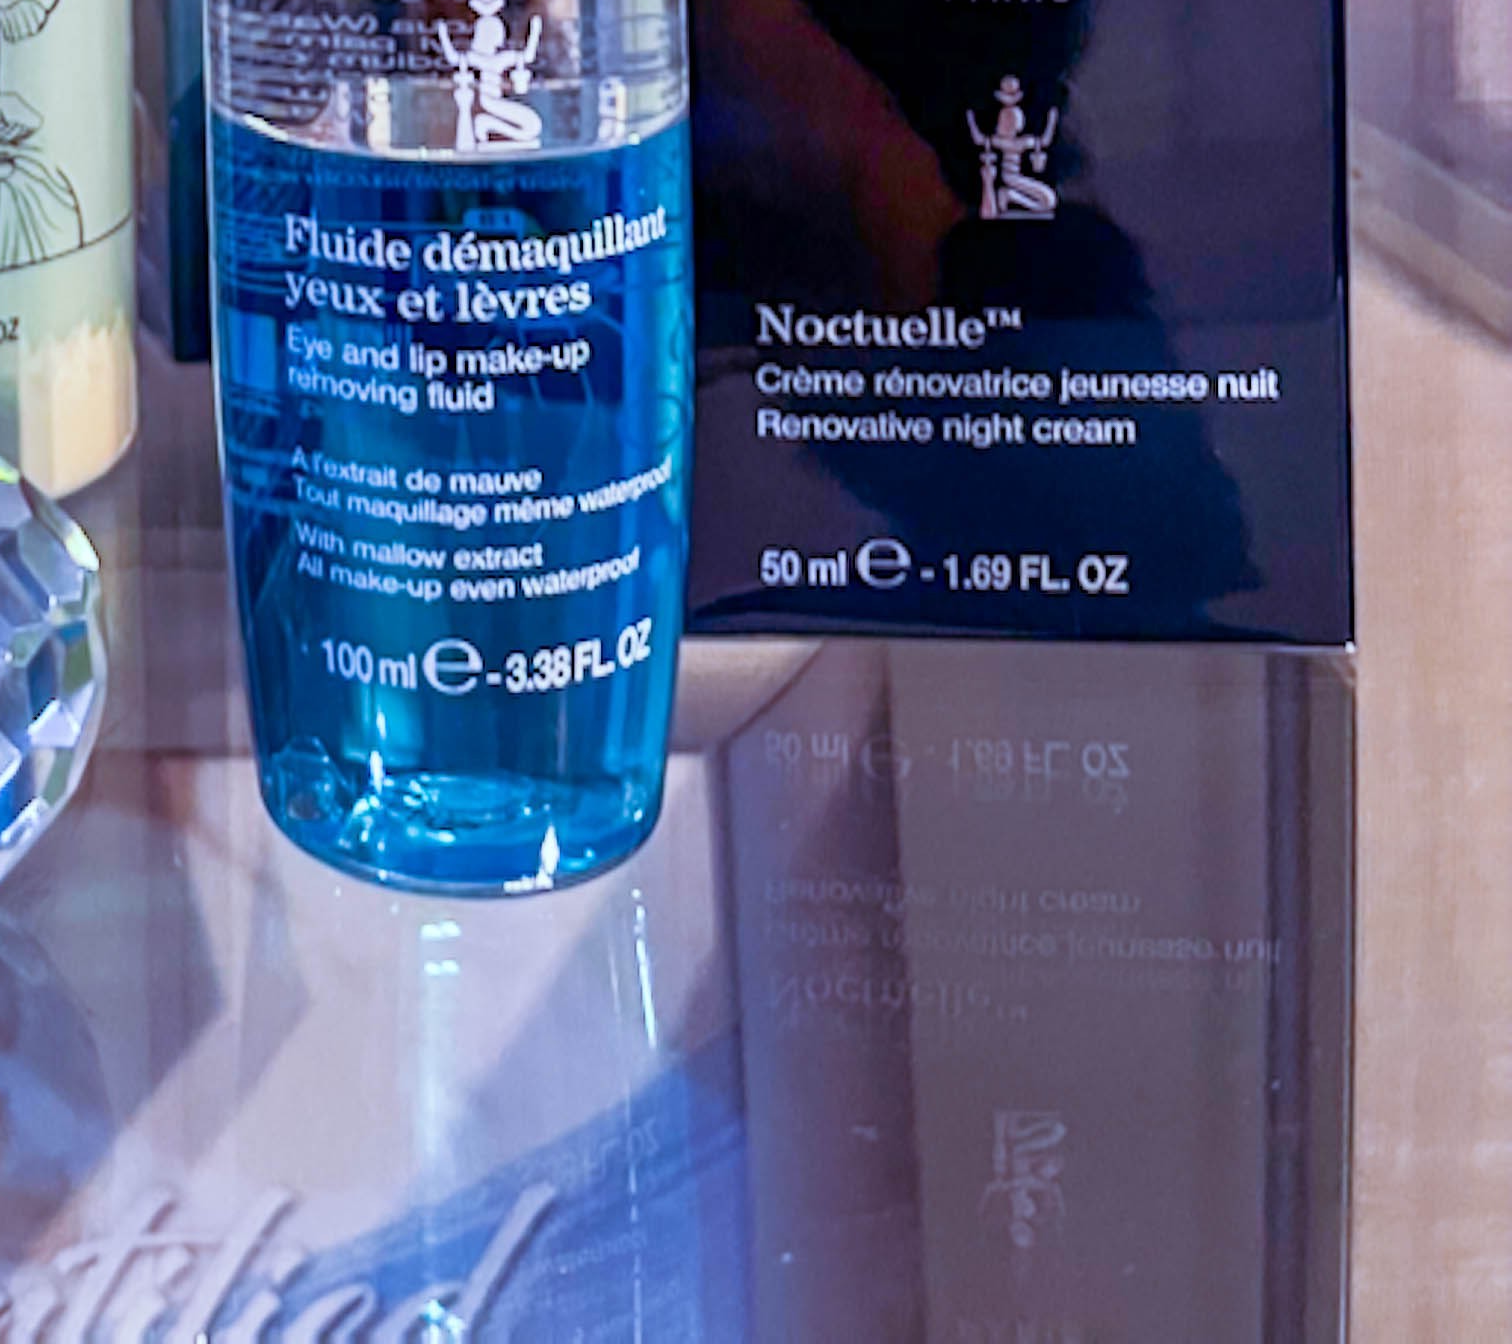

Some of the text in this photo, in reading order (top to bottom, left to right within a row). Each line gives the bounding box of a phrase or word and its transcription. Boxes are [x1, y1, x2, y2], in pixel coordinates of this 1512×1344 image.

[286, 206, 667, 275] Fluide démaquillant
[286, 272, 591, 322] yeux et lèvres
[288, 326, 589, 378] Eye and lip make-up
[288, 364, 494, 412] removing fluid
[756, 363, 1279, 405] Crème rénovatrice jeunesse nuit
[756, 409, 1136, 448] Renovative night cream
[290, 446, 307, 468] A
[405, 468, 441, 493] de
[450, 468, 542, 494] mauve
[295, 453, 673, 530] Tout maquillage même waterproof
[295, 522, 543, 572] With mallow extract
[297, 546, 640, 601] All make-up even waterproof
[760, 551, 802, 587] 50
[807, 551, 847, 587] ml
[943, 555, 1011, 591] 1.69
[1019, 555, 1070, 592] FL.
[1078, 554, 1130, 594] OZ
[321, 639, 372, 684] 100
[380, 652, 417, 690] ml
[617, 617, 653, 668] OZ
